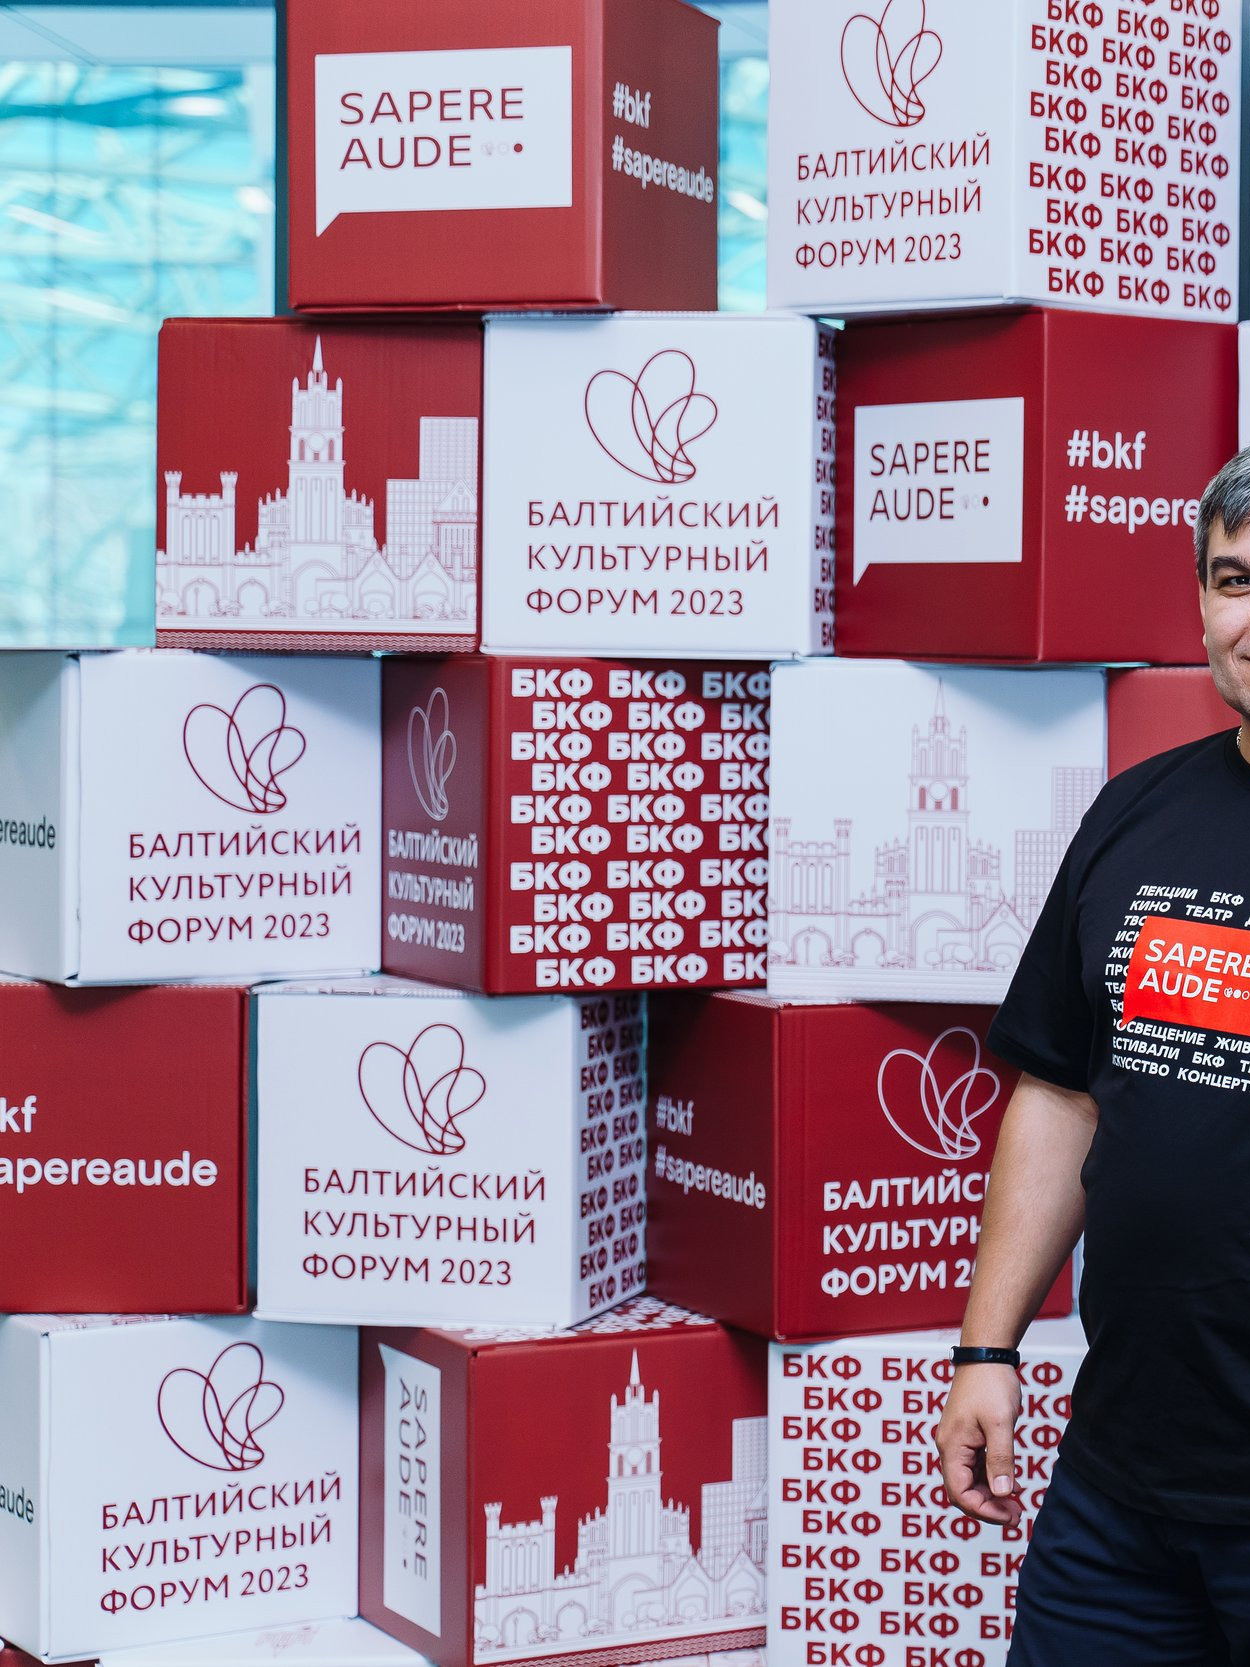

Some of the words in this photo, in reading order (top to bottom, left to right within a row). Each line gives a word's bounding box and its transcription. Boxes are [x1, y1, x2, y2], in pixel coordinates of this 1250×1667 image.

[1032, 25, 1088, 58] БКФ
[1103, 38, 1155, 71] БКФ
[1169, 52, 1217, 83] БКФ
[613, 82, 651, 128] #bkf
[1047, 60, 1101, 93] БКФ
[1116, 73, 1167, 104] БКФ
[1182, 85, 1229, 116] БКФ
[341, 88, 523, 124] SAPERE
[1031, 92, 1086, 124] БКФ
[1102, 104, 1154, 135] БКФ
[1168, 116, 1216, 146] БКФ
[340, 135, 471, 169] AUDE
[612, 135, 713, 203] #sapereaude
[798, 133, 989, 183] БАЛТИЙСКИЙ
[798, 179, 980, 224] КУЛЬТУРНЫЙ
[796, 238, 894, 269] ФОРУМ
[905, 233, 961, 262] 2023
[871, 440, 989, 476] SAPERE
[1067, 430, 1146, 470] #bkf
[529, 496, 777, 527] БАЛТИЙСКИЙ
[870, 488, 954, 520] AUDE
[529, 541, 767, 571] КУЛЬТУРНЫЙ
[527, 589, 657, 614] ФОРУМ
[671, 590, 743, 615] 2023
[512, 669, 592, 698] БКФ
[609, 670, 685, 699] БКФ
[533, 701, 612, 730] БКФ
[628, 702, 705, 731] БКФ
[511, 731, 592, 761] БКФ
[608, 732, 685, 761] БКФ
[532, 762, 612, 792] БКФ
[627, 762, 704, 791] БКФ
[130, 824, 359, 858] БАЛТИЙСКИЙ
[389, 829, 477, 868] БАЛТИЙСКИЙ
[130, 866, 350, 901] КУЛЬТУРНЫЙ
[389, 871, 473, 911] КУЛЬТУРНЫЙ
[1136, 885, 1198, 900] ЛЕКЦИИ
[1210, 892, 1244, 906] БКФ
[128, 916, 251, 944] ФОРУМ
[264, 913, 329, 938] 2023
[1130, 901, 1171, 912] КИНО
[1185, 905, 1233, 922] ТЕАТР
[388, 912, 435, 947] ФОРУМ
[436, 921, 464, 953] 2023
[1138, 968, 1222, 1003] AUDE
[1192, 1051, 1225, 1068] БКФ
[656, 1091, 693, 1137] #bkf
[305, 1167, 544, 1200] БАЛТИЙСКИЙ
[655, 1147, 766, 1209] #sapereaude
[305, 1211, 534, 1243] КУЛЬТУРНЫЙ
[303, 1254, 428, 1282] ФОРУМ
[442, 1259, 511, 1285] 2023
[821, 1260, 946, 1298] ФОРУМ
[782, 1352, 861, 1380] БКФ
[804, 1387, 882, 1412] БКФ
[783, 1416, 861, 1442] БКФ
[399, 1378, 411, 1517] AUDE
[804, 1448, 881, 1474] БКФ
[101, 1469, 341, 1531] БАЛТИЙСКИЙ
[415, 1386, 427, 1580] SAPERE
[803, 1510, 881, 1536] БКФ
[901, 1514, 981, 1540] БКФ
[100, 1514, 331, 1573] КУЛЬТУРНЫЙ
[782, 1545, 860, 1571] БКФ
[881, 1549, 959, 1575] БКФ
[101, 1575, 228, 1614] ФОРУМ
[241, 1564, 308, 1596] 2023
[805, 1577, 883, 1603] БКФ
